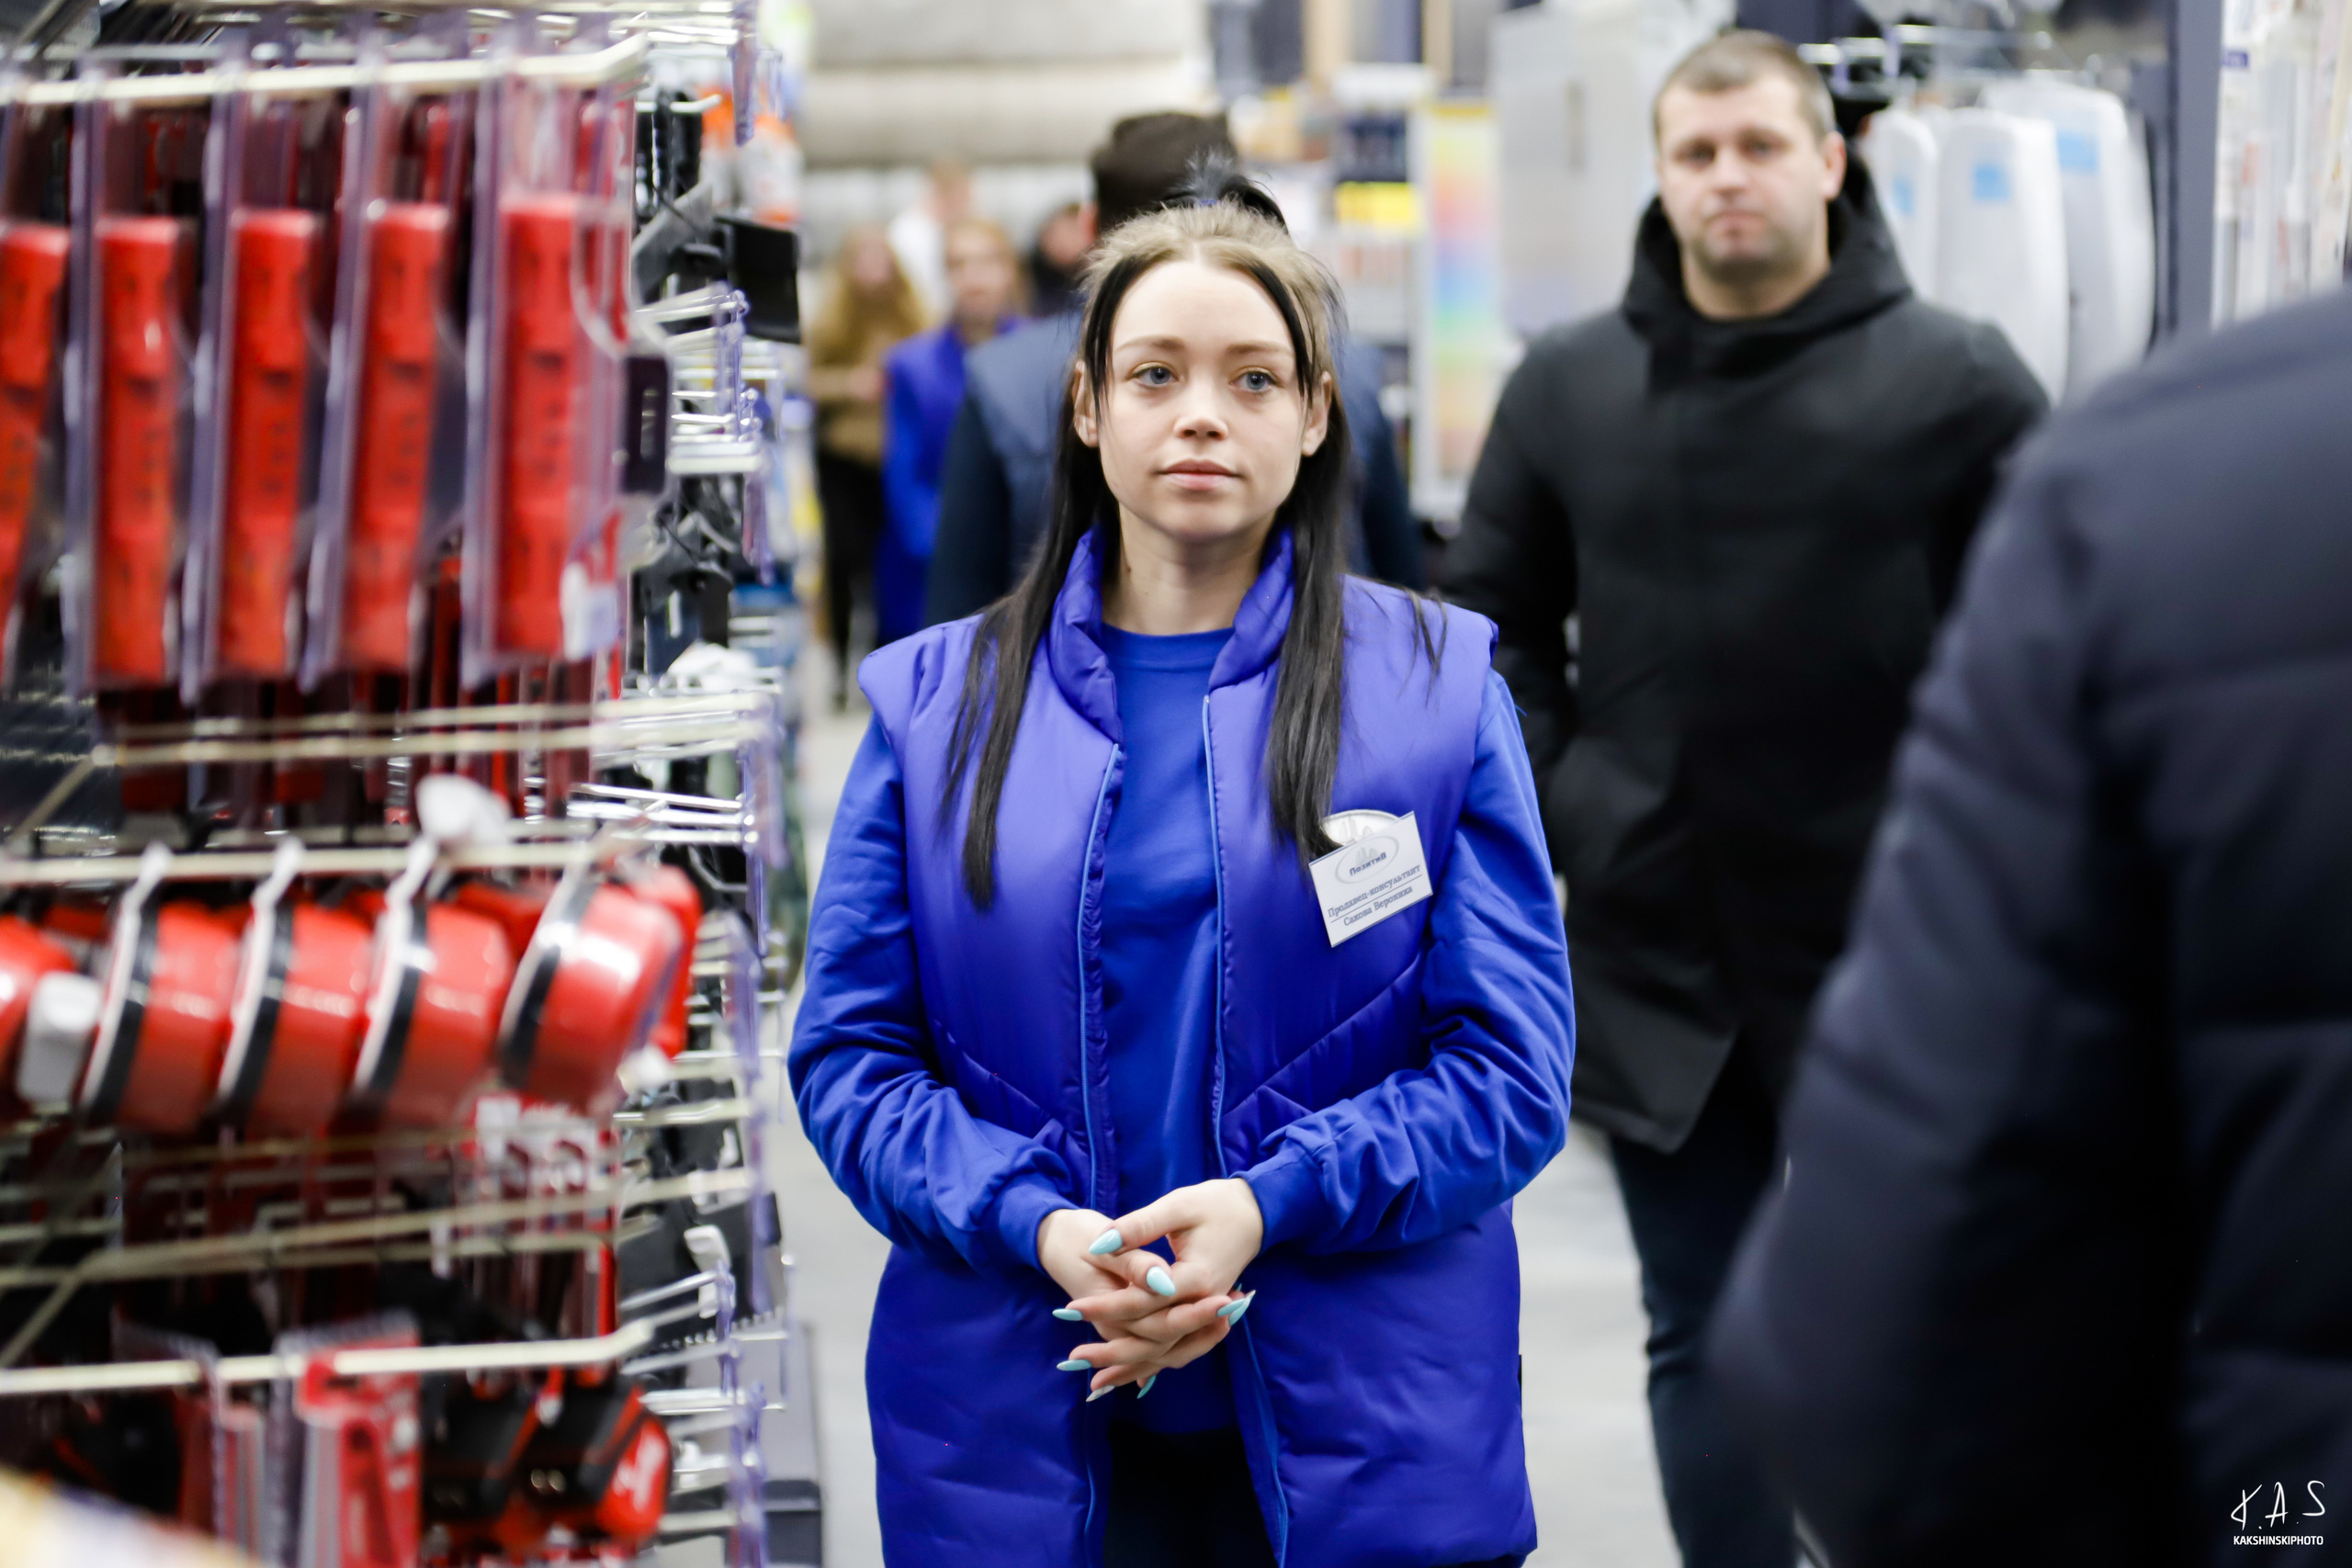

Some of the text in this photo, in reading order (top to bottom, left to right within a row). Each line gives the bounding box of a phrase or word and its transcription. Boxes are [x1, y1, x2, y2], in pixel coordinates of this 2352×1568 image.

[1328, 864, 1420, 919] Продавец-консультант
[1343, 886, 1413, 927] Сакова Вероника
